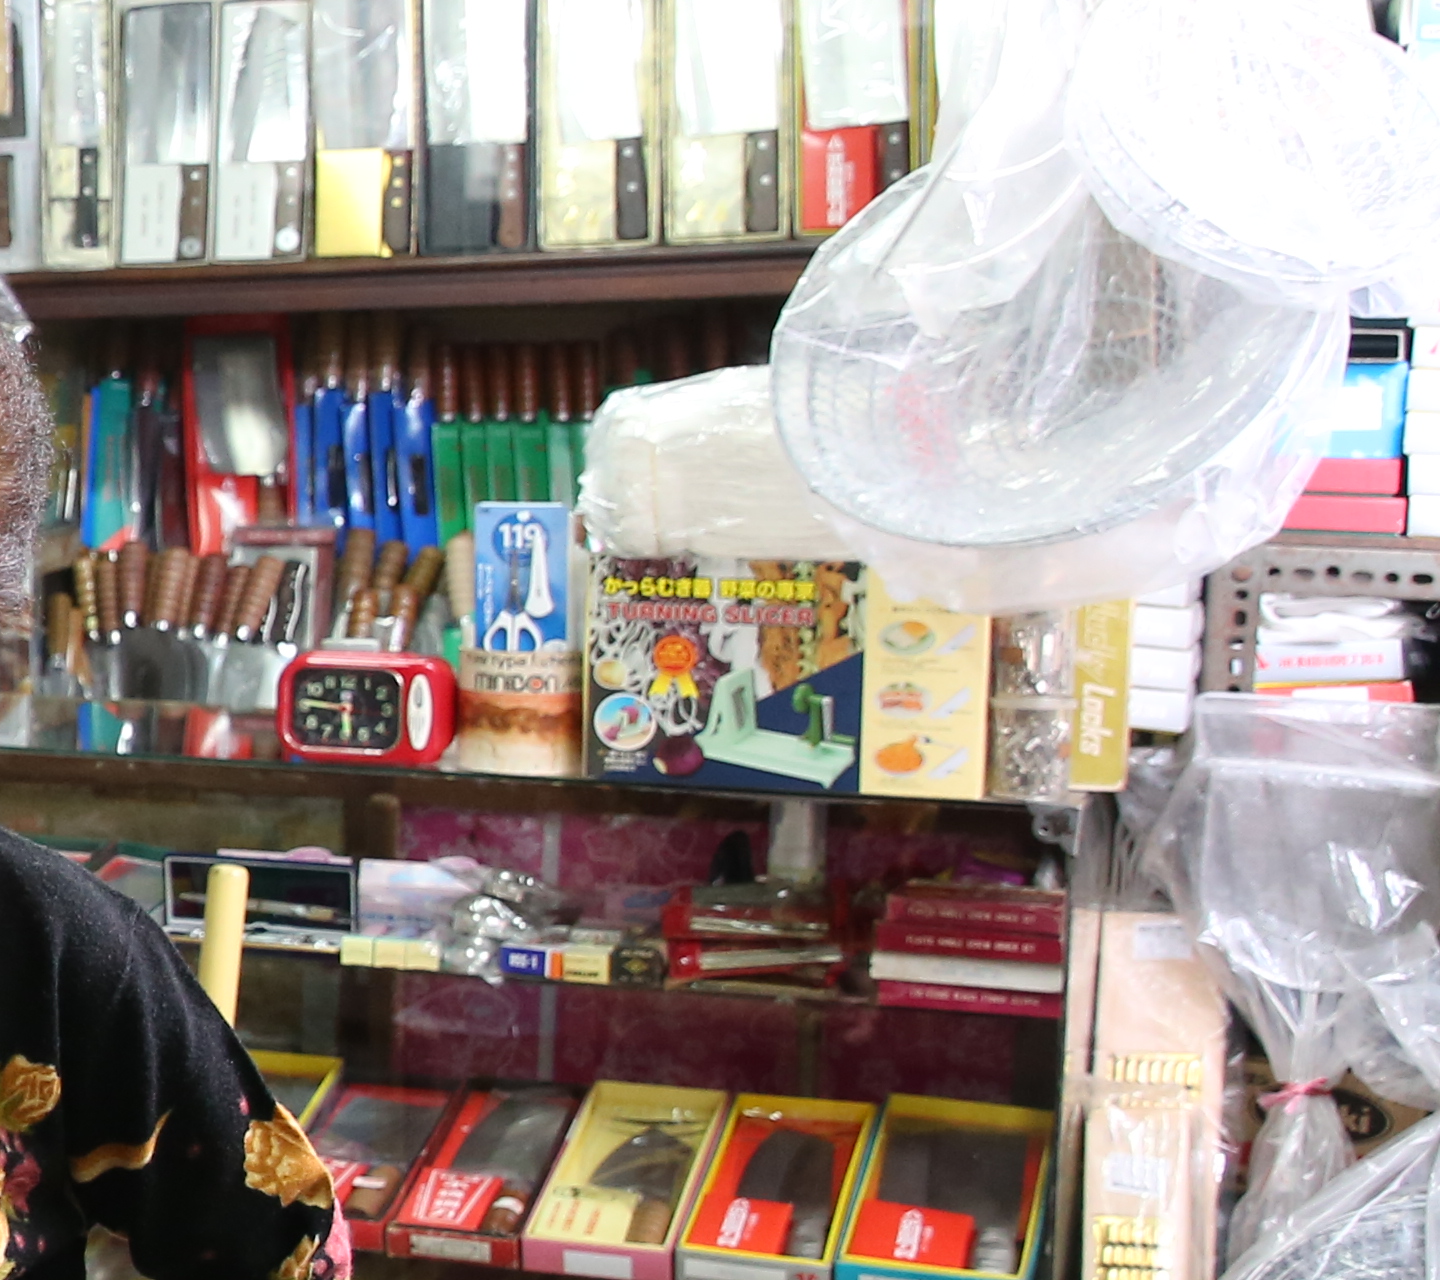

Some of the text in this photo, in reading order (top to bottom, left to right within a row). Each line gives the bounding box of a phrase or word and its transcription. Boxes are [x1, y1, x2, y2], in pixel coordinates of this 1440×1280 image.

[498, 522, 538, 548] 119
[605, 602, 815, 626] TURNING SLICER
[1078, 682, 1117, 757] Locks
